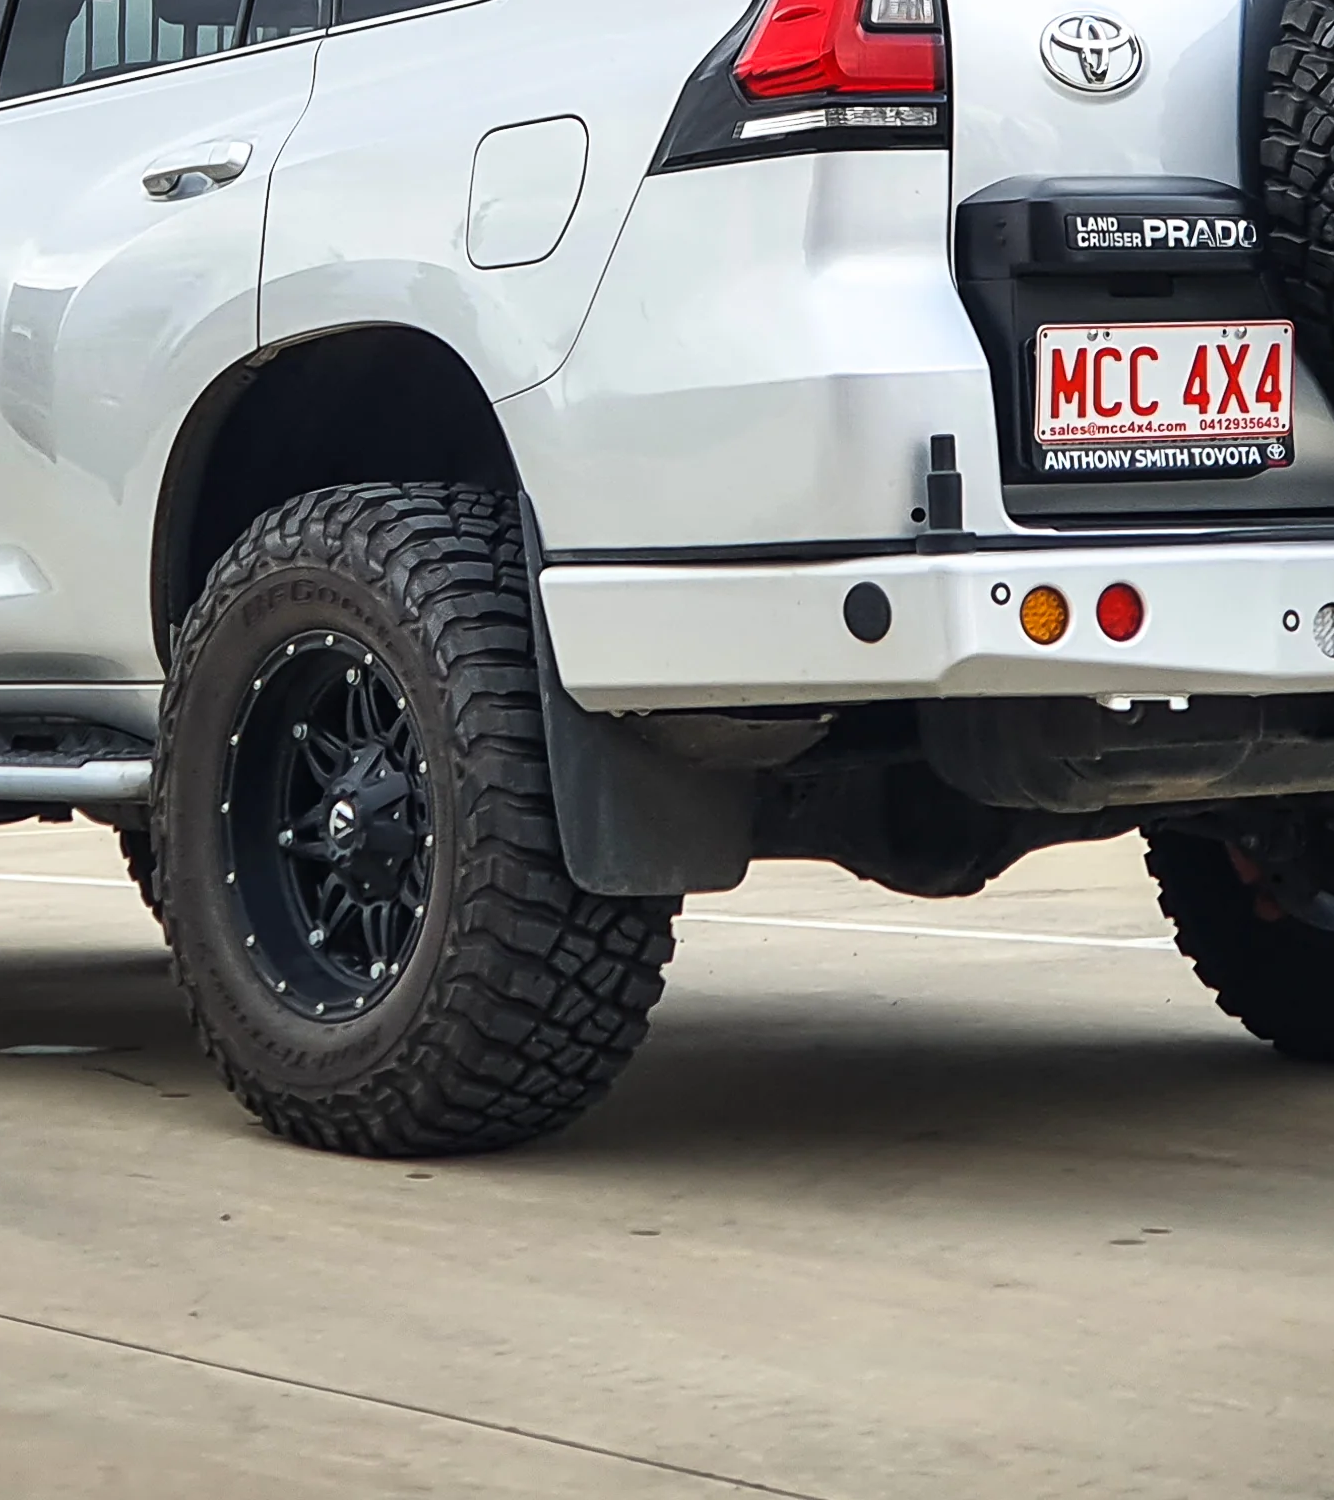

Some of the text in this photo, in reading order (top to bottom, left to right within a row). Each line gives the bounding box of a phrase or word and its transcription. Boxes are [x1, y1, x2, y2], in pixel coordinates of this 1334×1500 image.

[1076, 216, 1119, 232] LAND
[1143, 218, 1257, 248] PRADO
[1076, 232, 1142, 248] CRUISER
[1050, 343, 1282, 419] MCC 4X4
[1049, 416, 1280, 436] sales@mcc4x4.com 0412935643
[1044, 446, 1262, 471] ANTHONY SMITH TOYOTA
